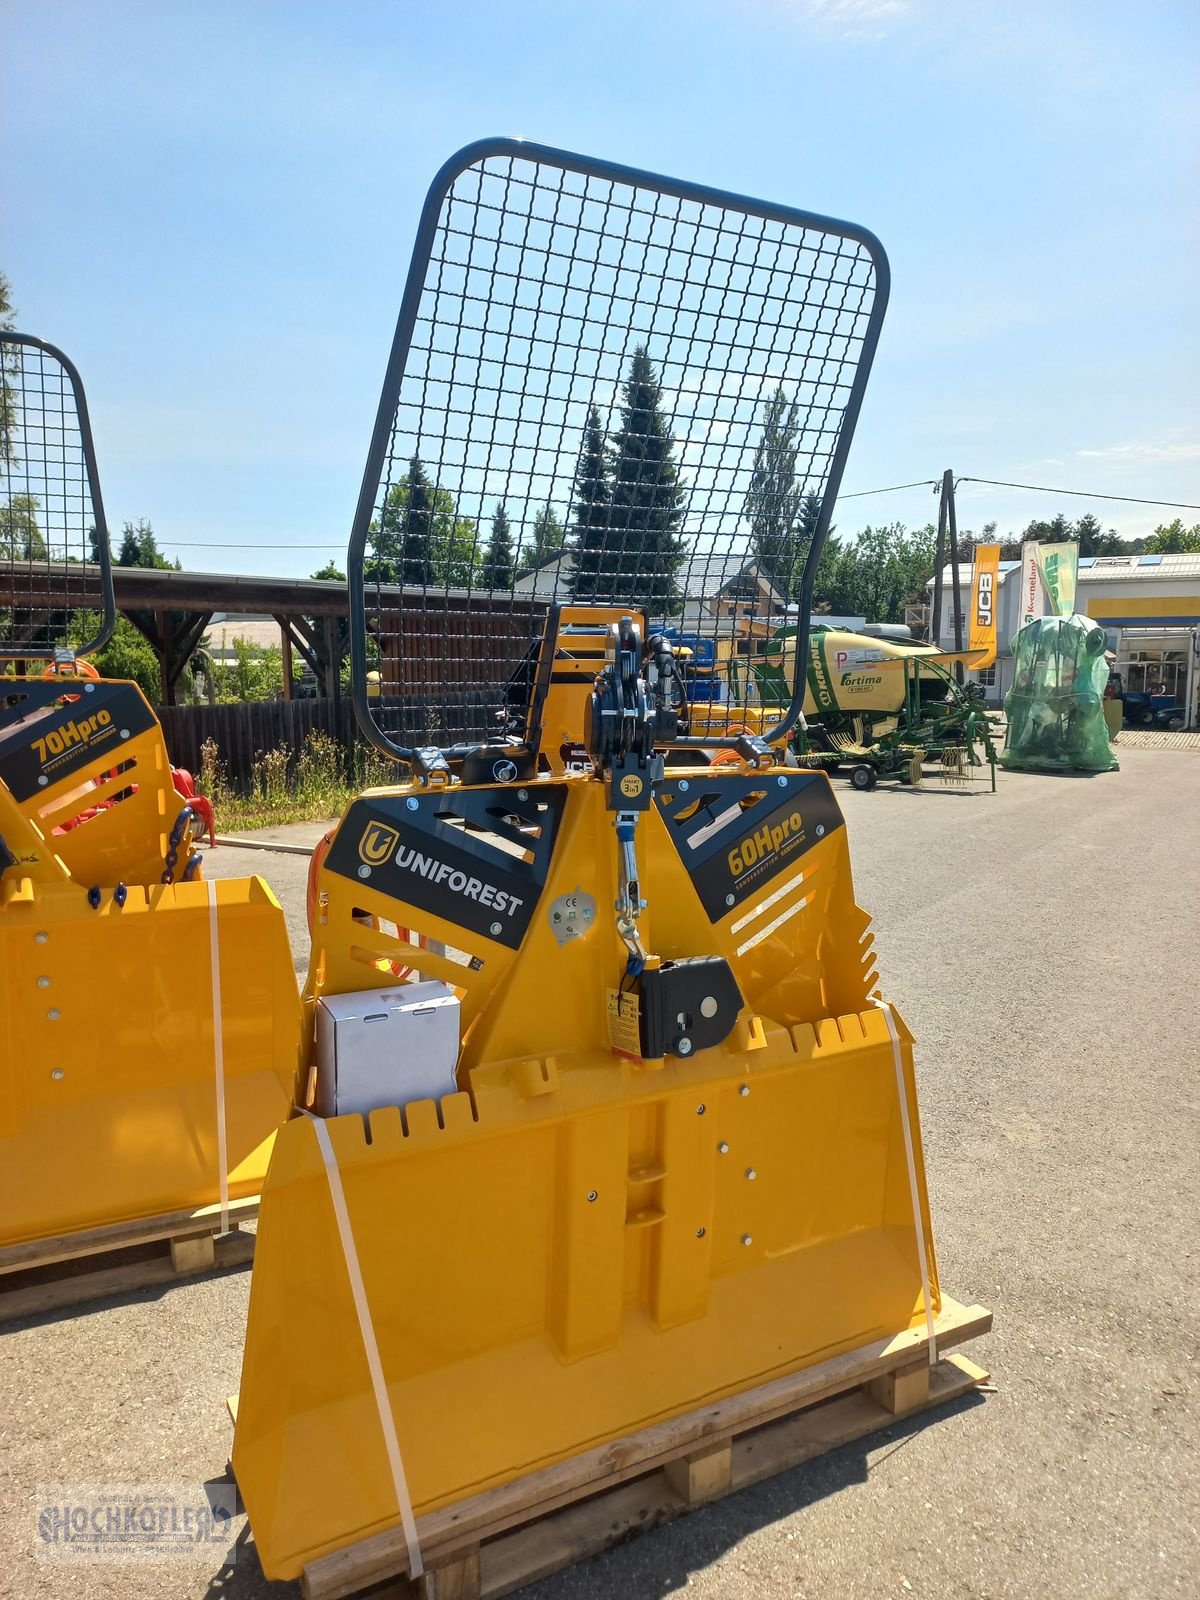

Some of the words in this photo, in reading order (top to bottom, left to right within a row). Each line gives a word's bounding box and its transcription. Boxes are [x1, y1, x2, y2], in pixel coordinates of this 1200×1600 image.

[978, 573, 993, 626] JCB
[811, 637, 828, 690] KRONE
[840, 672, 882, 686] Fortima
[31, 709, 112, 764] 70Hpro
[624, 784, 639, 793] 3in1
[728, 812, 802, 877] 60Hpro
[394, 844, 524, 918] UNIFOREST
